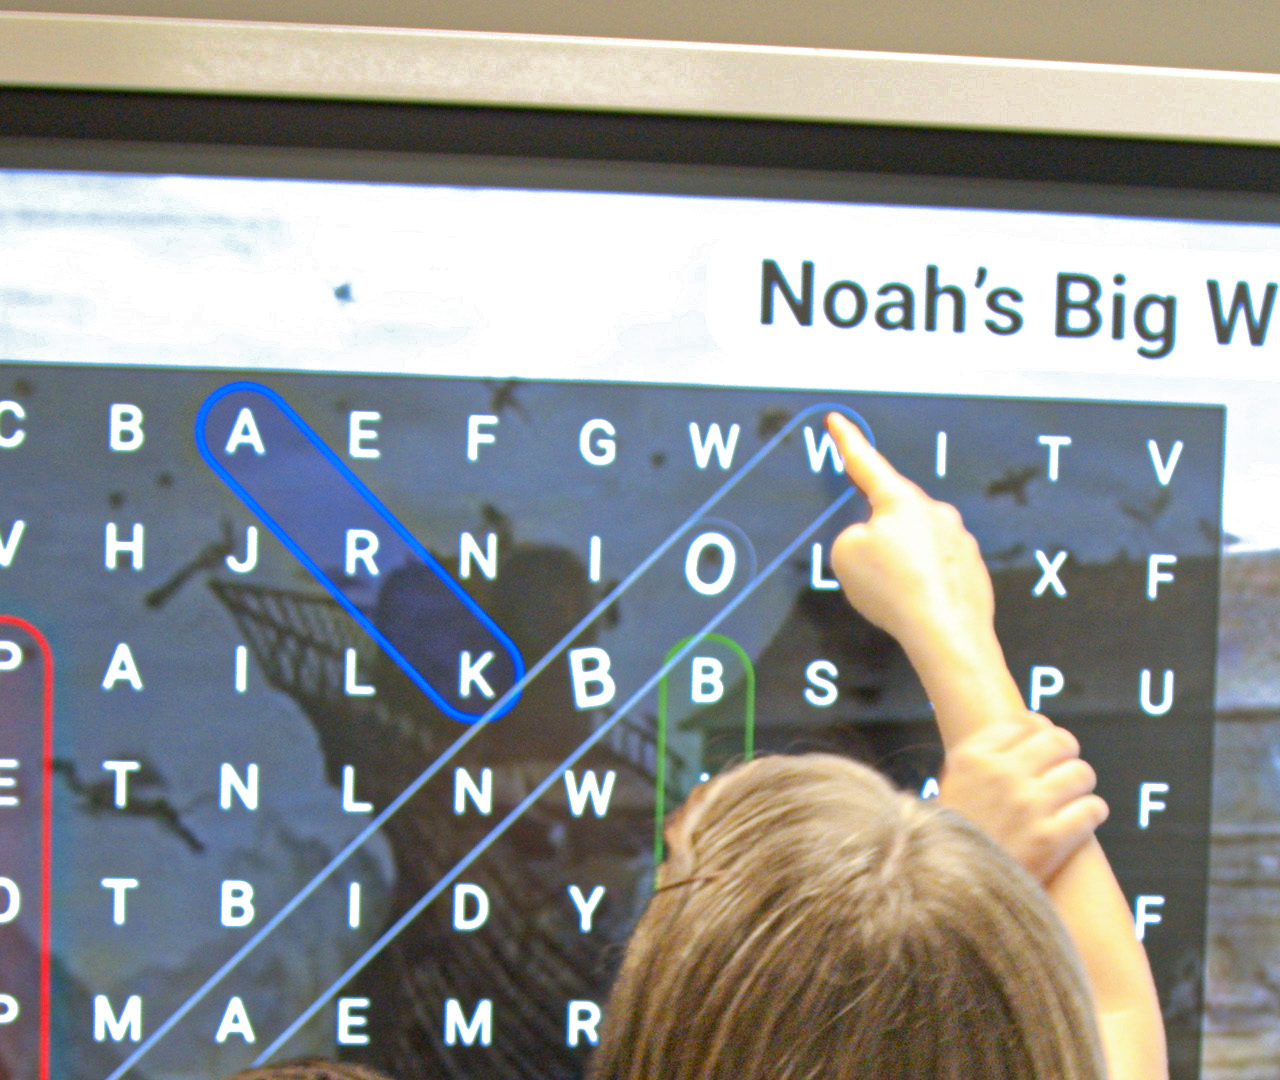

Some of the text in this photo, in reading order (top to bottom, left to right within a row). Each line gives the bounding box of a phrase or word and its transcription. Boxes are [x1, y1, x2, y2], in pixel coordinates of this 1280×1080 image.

[1055, 272, 1177, 359] Big
[109, 402, 145, 452] B
[224, 406, 266, 455] A
[348, 409, 382, 460] E
[466, 413, 500, 462] F
[578, 417, 617, 467] G
[688, 421, 741, 471] W
[935, 430, 948, 478] I
[1038, 434, 1073, 482] T
[1147, 438, 1185, 486] V
[104, 521, 145, 571] H
[225, 525, 259, 574] J
[345, 528, 380, 576] R
[459, 531, 498, 580] N
[589, 534, 602, 583] I
[684, 531, 737, 596] O
[811, 542, 840, 590] L
[1033, 549, 1068, 597] X
[1147, 553, 1178, 600] F
[101, 642, 144, 691] A
[234, 644, 248, 693] I
[345, 647, 376, 696] L
[459, 650, 495, 698] K
[568, 646, 617, 709] B
[690, 655, 725, 704] B
[804, 659, 839, 707] S
[1030, 665, 1065, 712] P
[1139, 668, 1175, 716] U
[102, 759, 140, 808] T
[219, 761, 259, 811] N
[342, 765, 374, 813] L
[454, 766, 493, 815] N
[563, 768, 617, 817] W
[1139, 782, 1170, 828] F
[100, 877, 140, 926] T
[220, 879, 256, 928] B
[348, 881, 361, 929] I
[453, 882, 490, 931] D
[568, 884, 605, 932] Y
[1134, 894, 1166, 943] F
[93, 993, 143, 1043] M
[215, 995, 256, 1044] A
[337, 997, 370, 1045] E
[445, 998, 493, 1046] M
[567, 999, 602, 1047] R
